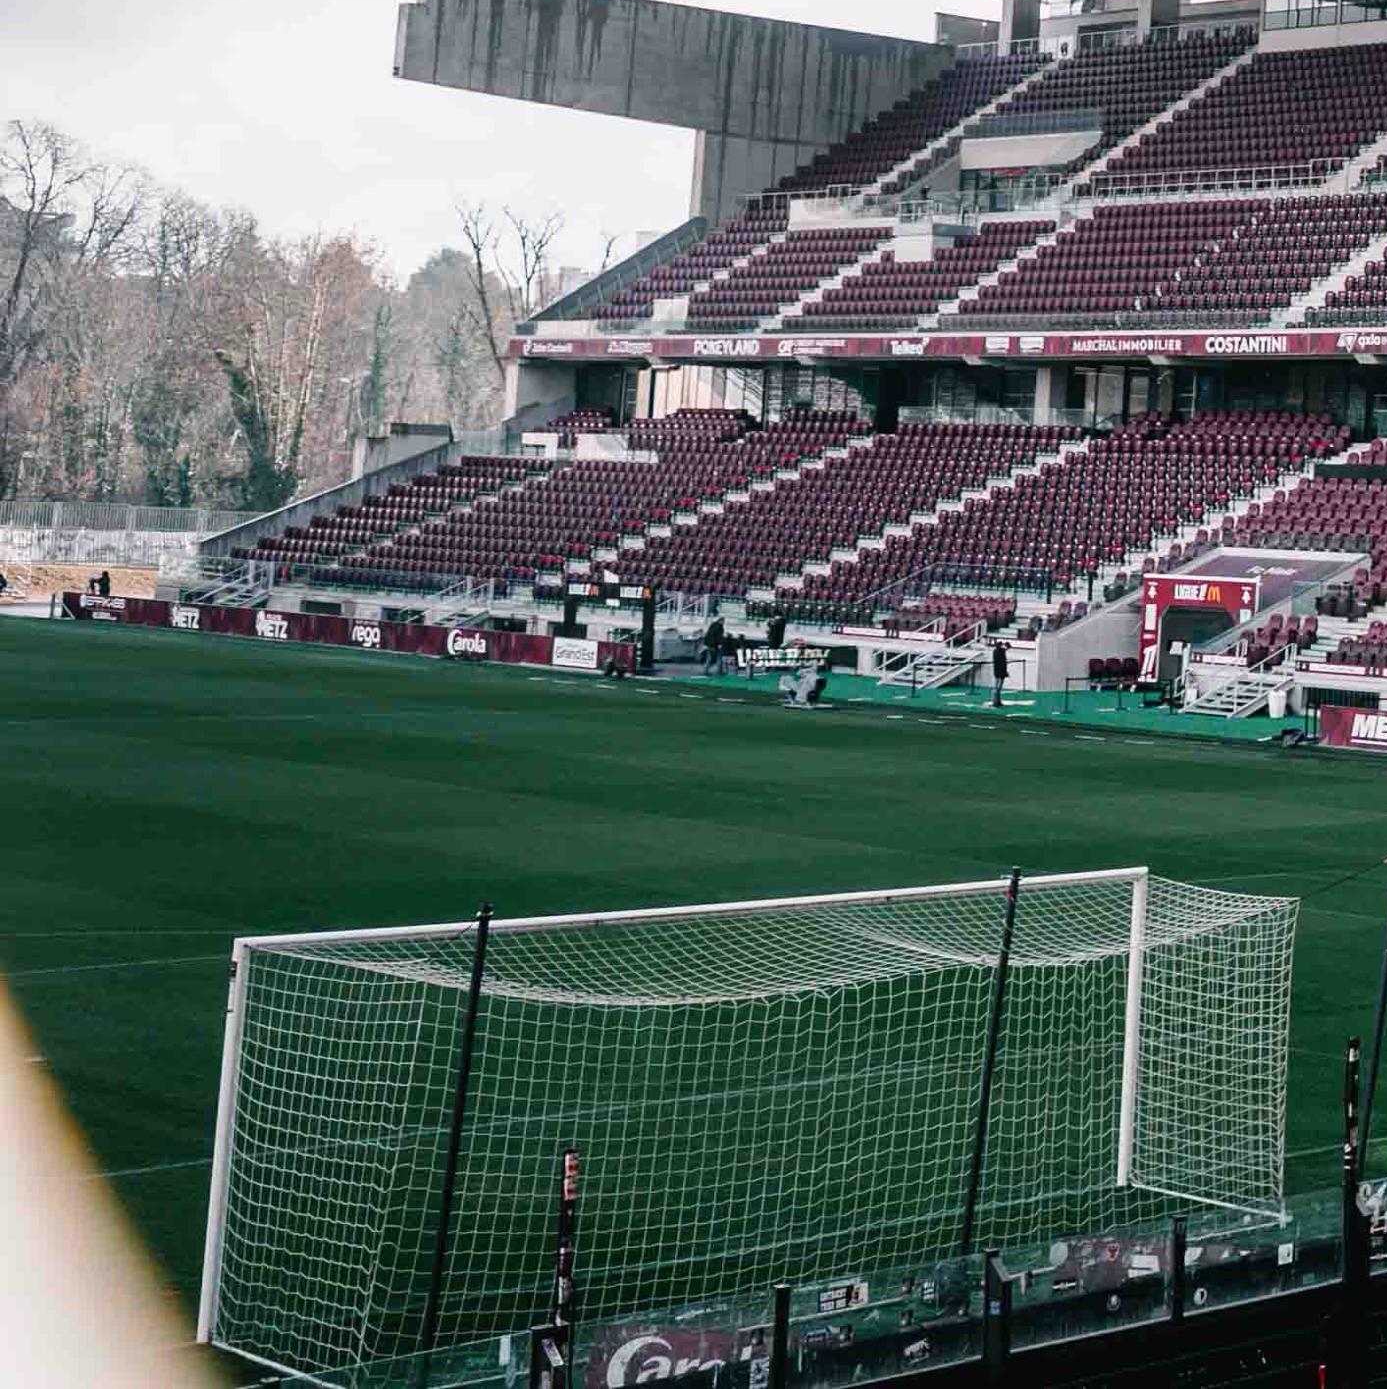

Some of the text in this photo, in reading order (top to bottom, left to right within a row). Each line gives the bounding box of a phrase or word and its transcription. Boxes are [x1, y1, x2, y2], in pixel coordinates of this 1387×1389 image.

[1072, 339, 1182, 352] MARCHAL IMMOBILIER
[1205, 337, 1287, 353] COSTANTINI
[257, 619, 288, 639] METZ
[447, 629, 487, 656] Carola
